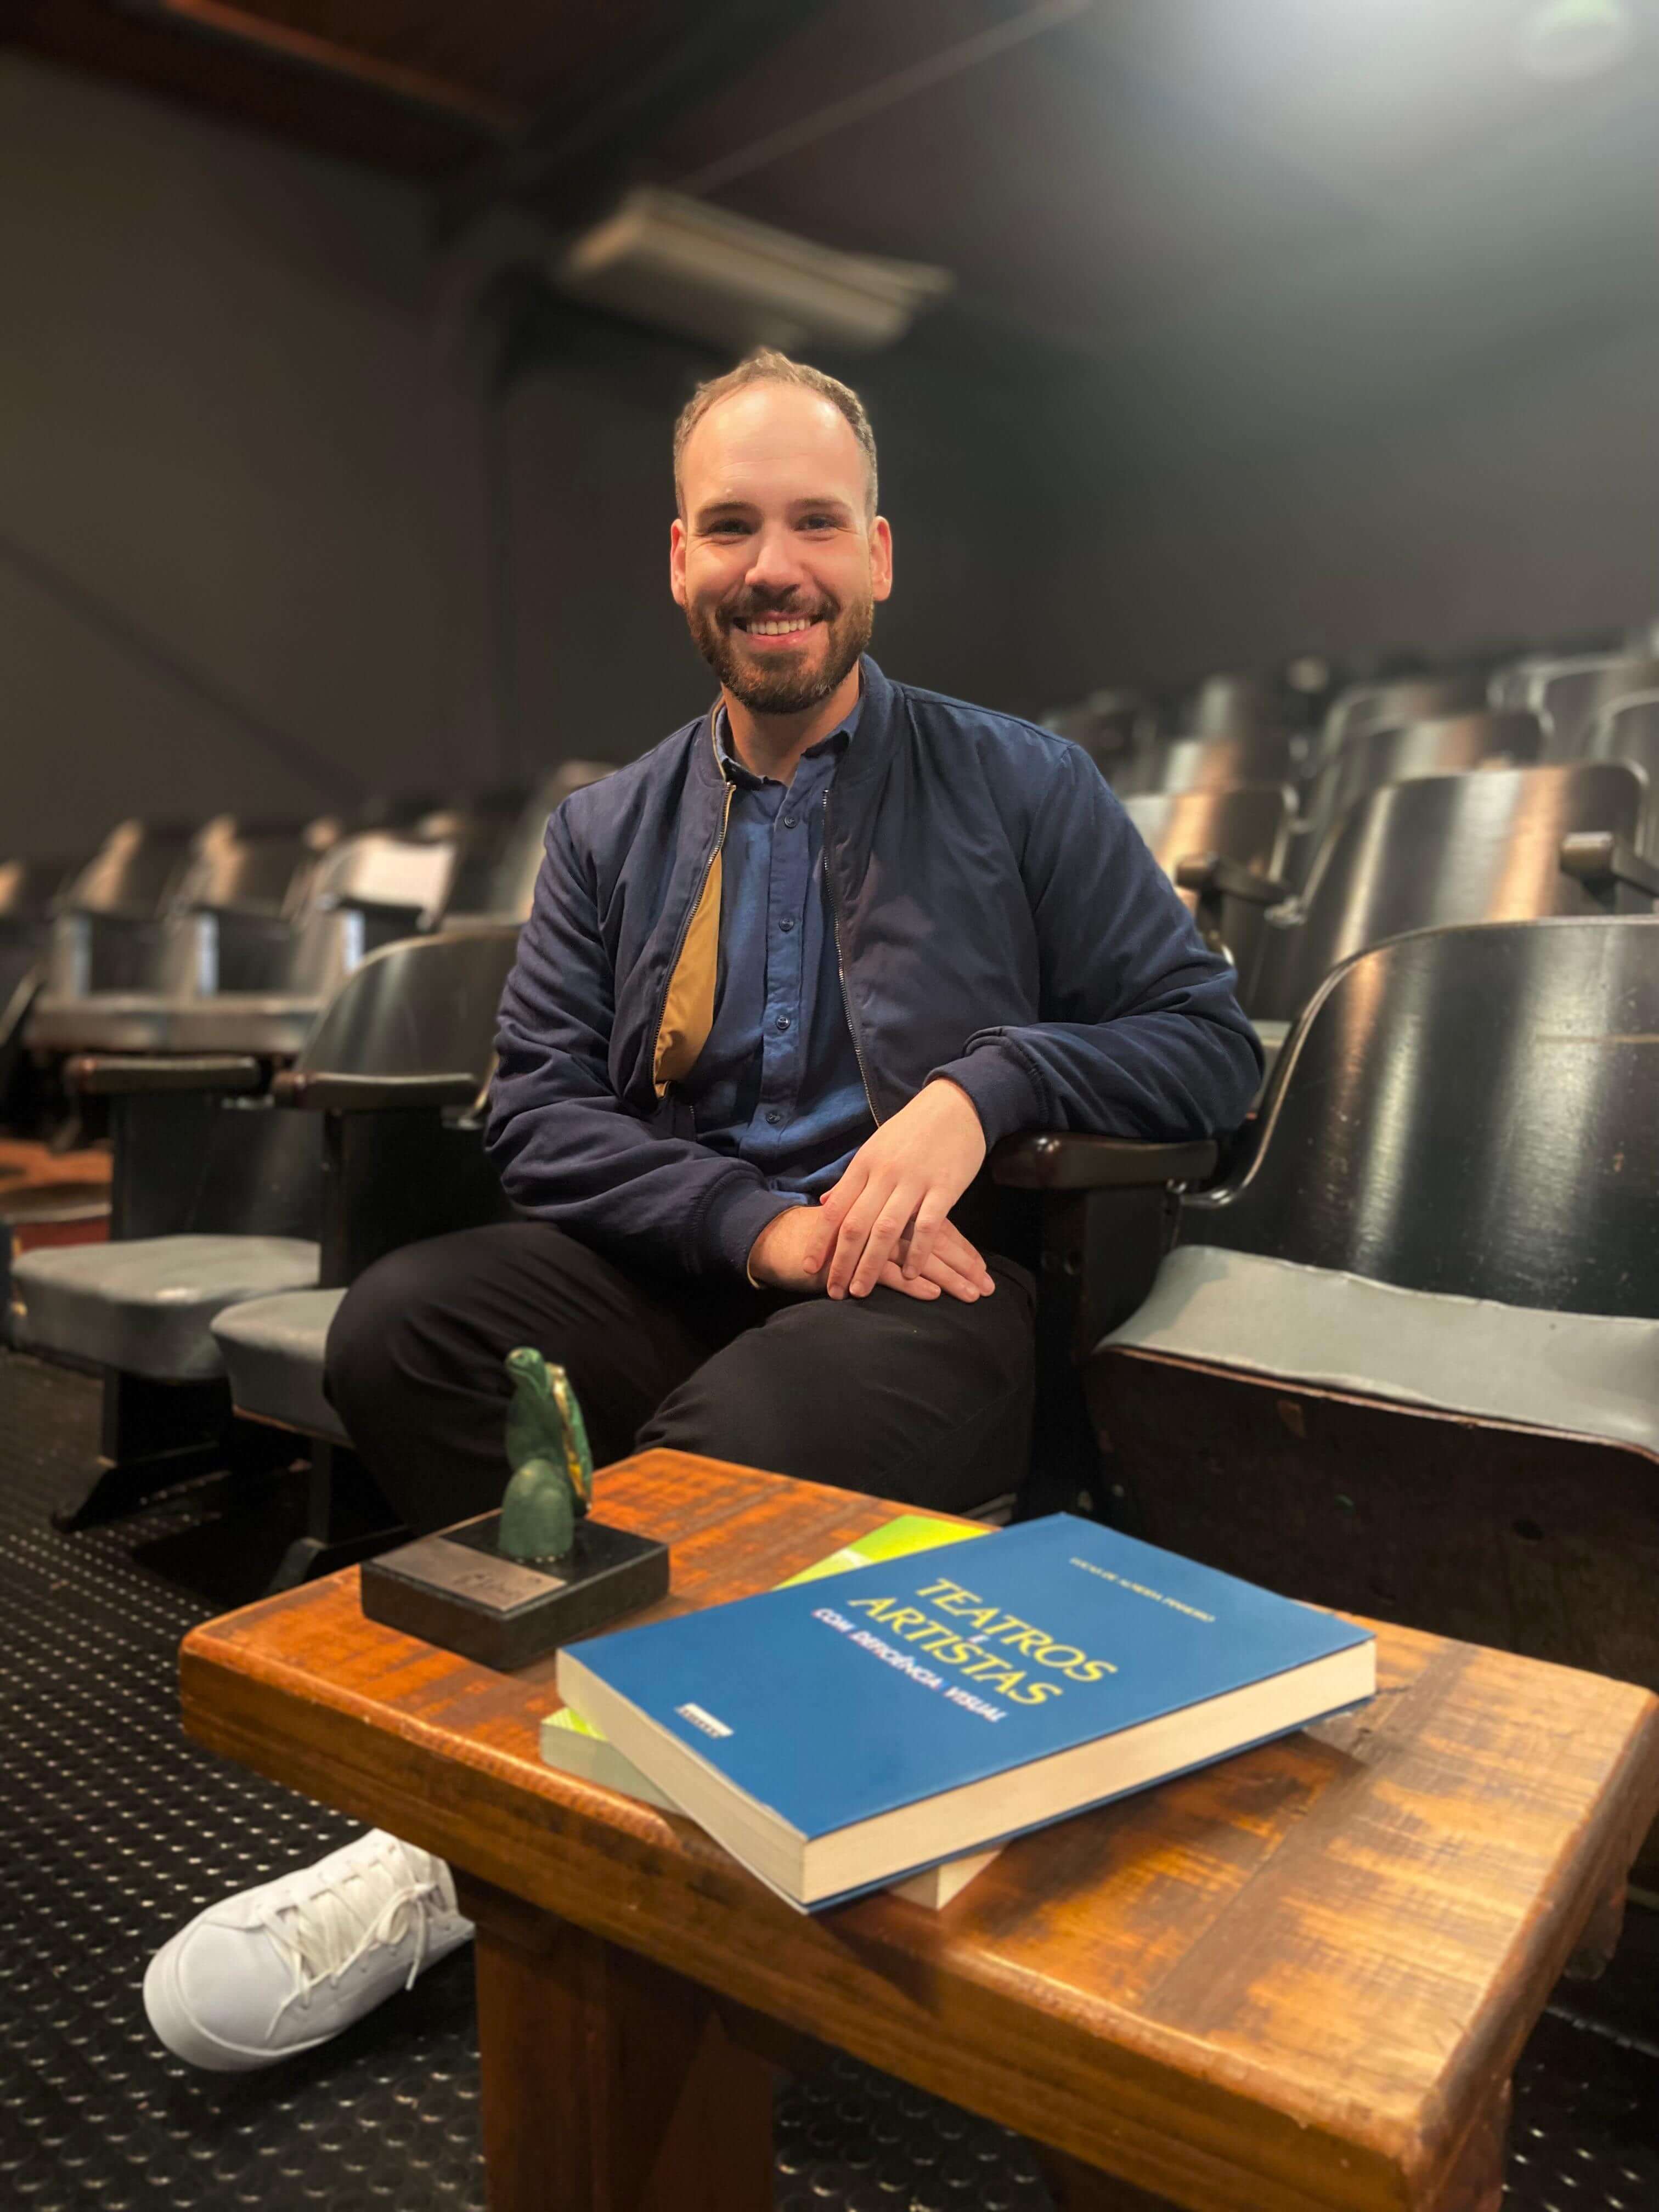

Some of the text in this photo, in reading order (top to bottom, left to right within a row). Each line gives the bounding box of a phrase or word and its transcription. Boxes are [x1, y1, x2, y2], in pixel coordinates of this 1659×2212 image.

[848, 1597, 1063, 1705] ARTISTAS
[915, 1577, 1118, 1681] TEATROS
[943, 1686, 1009, 1723] VISUAL
